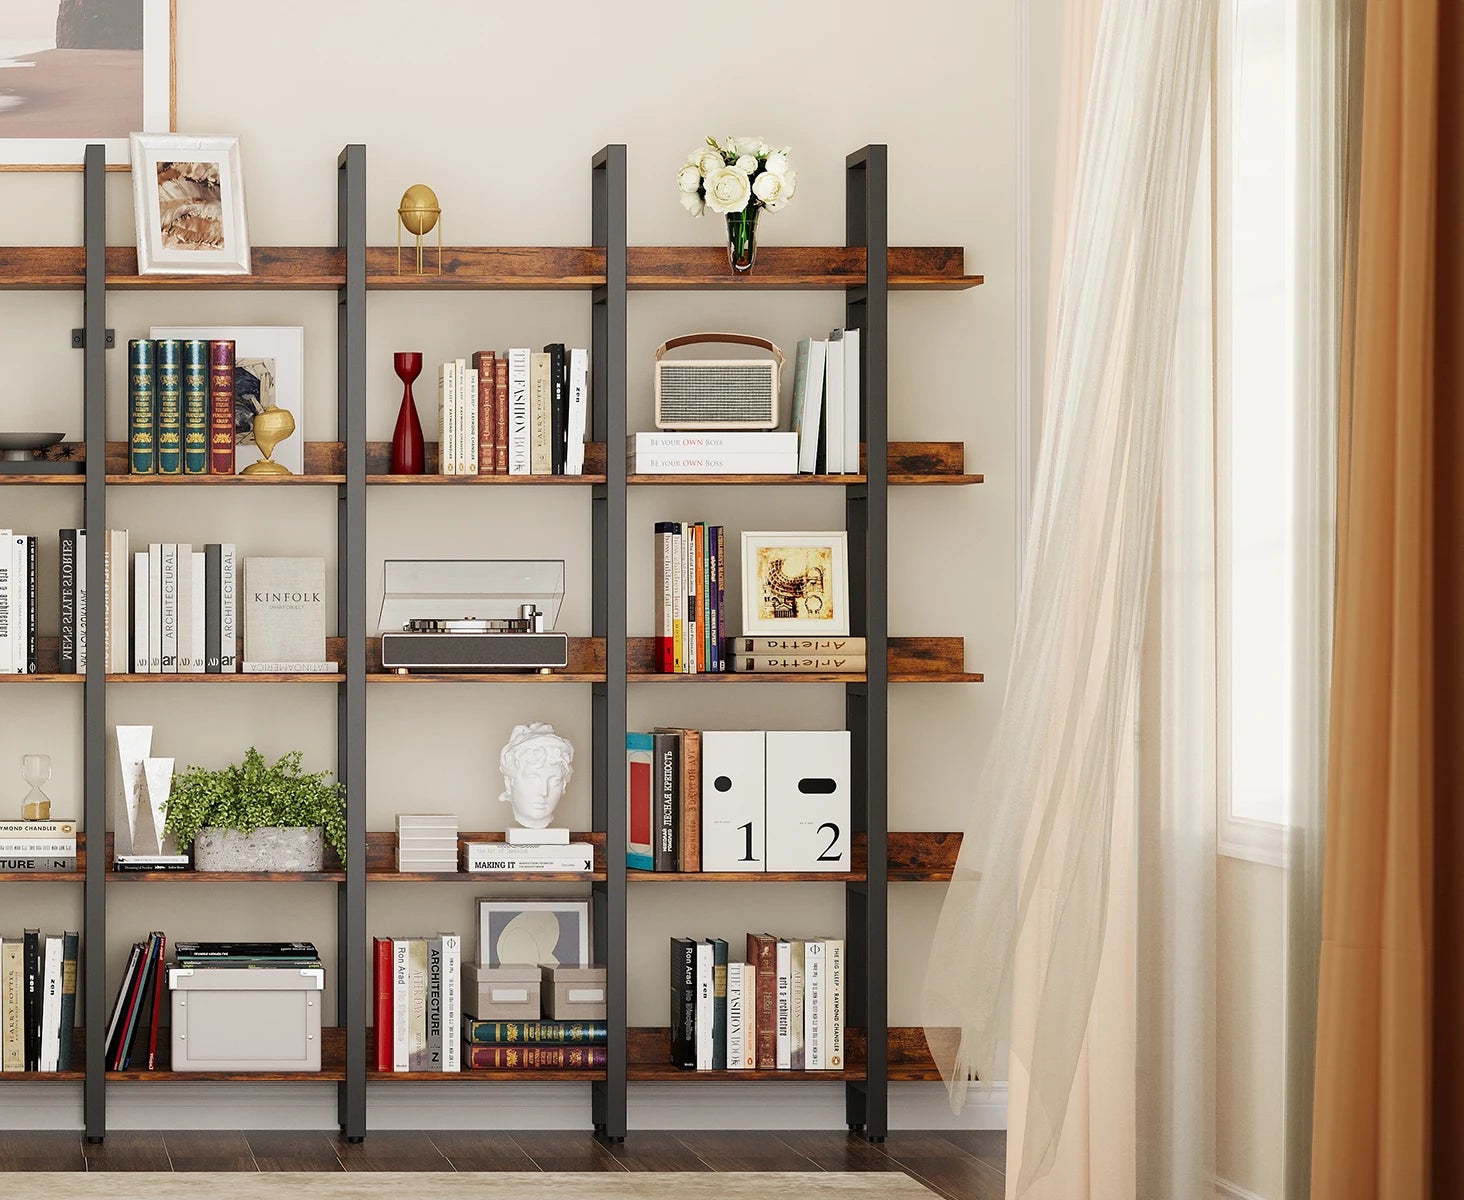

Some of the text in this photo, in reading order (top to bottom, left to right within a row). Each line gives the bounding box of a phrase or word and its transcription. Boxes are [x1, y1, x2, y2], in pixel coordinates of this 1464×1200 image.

[514, 351, 526, 471] THE FASHION BOOK
[165, 552, 173, 639] ARCHITECTURAL
[224, 552, 232, 639] ARCHITECTURAL
[255, 593, 321, 602] KINFOLK
[767, 641, 846, 650] Arletta
[768, 660, 846, 668] Arletta
[664, 751, 672, 826] ЛЕСНАЯ КРЕПОСТЬ
[737, 822, 760, 861] 1
[816, 822, 843, 861] 2
[431, 949, 440, 1036] ARCHITECTURE
[731, 965, 740, 1065] THE FASHION BOOK
